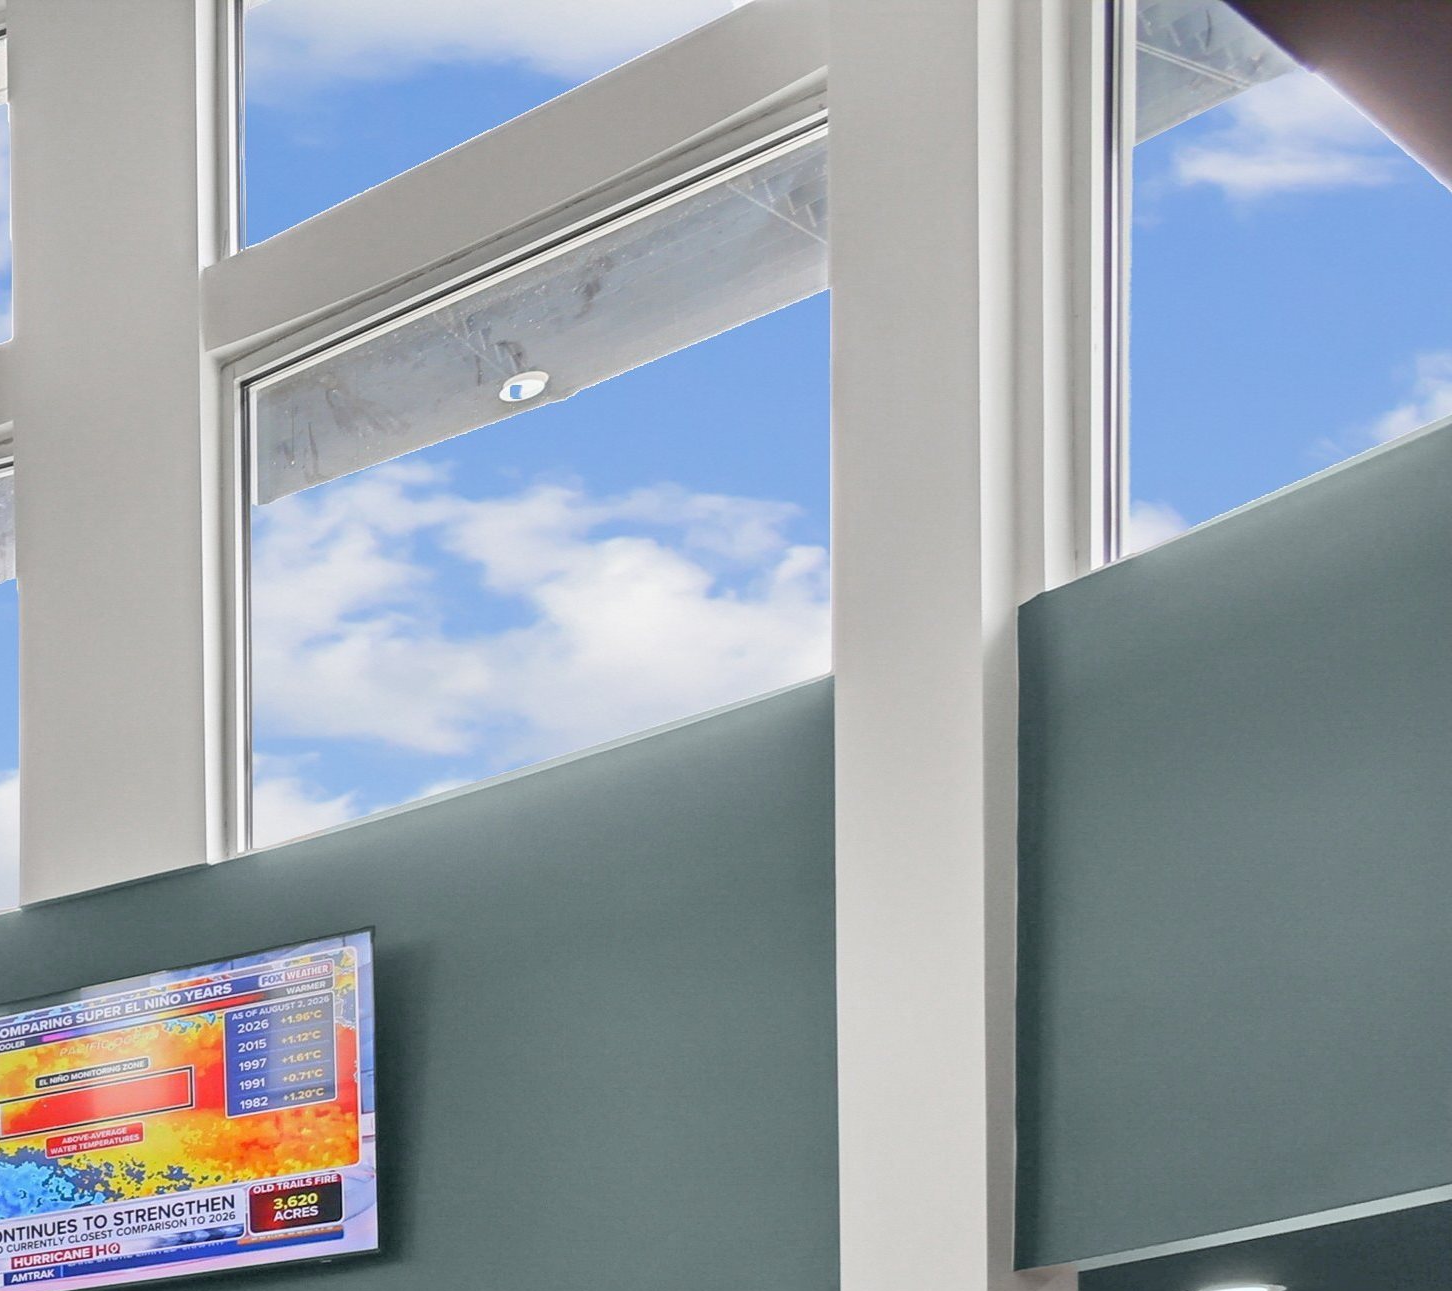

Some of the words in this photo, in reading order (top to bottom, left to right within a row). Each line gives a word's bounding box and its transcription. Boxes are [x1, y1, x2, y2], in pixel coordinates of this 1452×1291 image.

[261, 973, 283, 987] FOX
[286, 964, 329, 980] WEATHER
[286, 981, 326, 995] WARMER
[75, 1002, 121, 1024] SUPER
[125, 1000, 141, 1016] EL
[184, 983, 233, 1003] YEARS
[231, 1012, 244, 1021] AS
[245, 1009, 256, 1017] OF
[259, 1002, 295, 1015] AUGUST
[307, 996, 330, 1006] 2026
[237, 1019, 269, 1034] 2026
[238, 1039, 267, 1053] 2015
[39, 1077, 48, 1087] EL
[71, 1064, 121, 1081] MONITORING
[123, 1060, 145, 1072] ZONE
[238, 1057, 267, 1072] 1997
[239, 1077, 266, 1091] 1991
[239, 1096, 269, 1110] 1982
[50, 1143, 78, 1155] WATER
[78, 1134, 140, 1151] TEMPERATURES
[61, 1127, 127, 1144] ABOVE-AVERAGE
[252, 1185, 275, 1195] OLD
[276, 1179, 313, 1191] TRAILS
[314, 1174, 338, 1184] FIRE
[273, 1192, 319, 1210] 3,620
[83, 1213, 108, 1231] TO
[113, 1194, 236, 1226] STRENGTHEN
[273, 1205, 319, 1222] ACRES
[6, 1236, 65, 1254] CURRENTLY
[68, 1229, 113, 1244] CLOSEST
[116, 1218, 188, 1237] COMPARISON
[191, 1216, 206, 1226] TO
[208, 1210, 236, 1224] 2026
[13, 1248, 91, 1268] HURRICANE
[10, 1269, 55, 1284] AMTRAK
